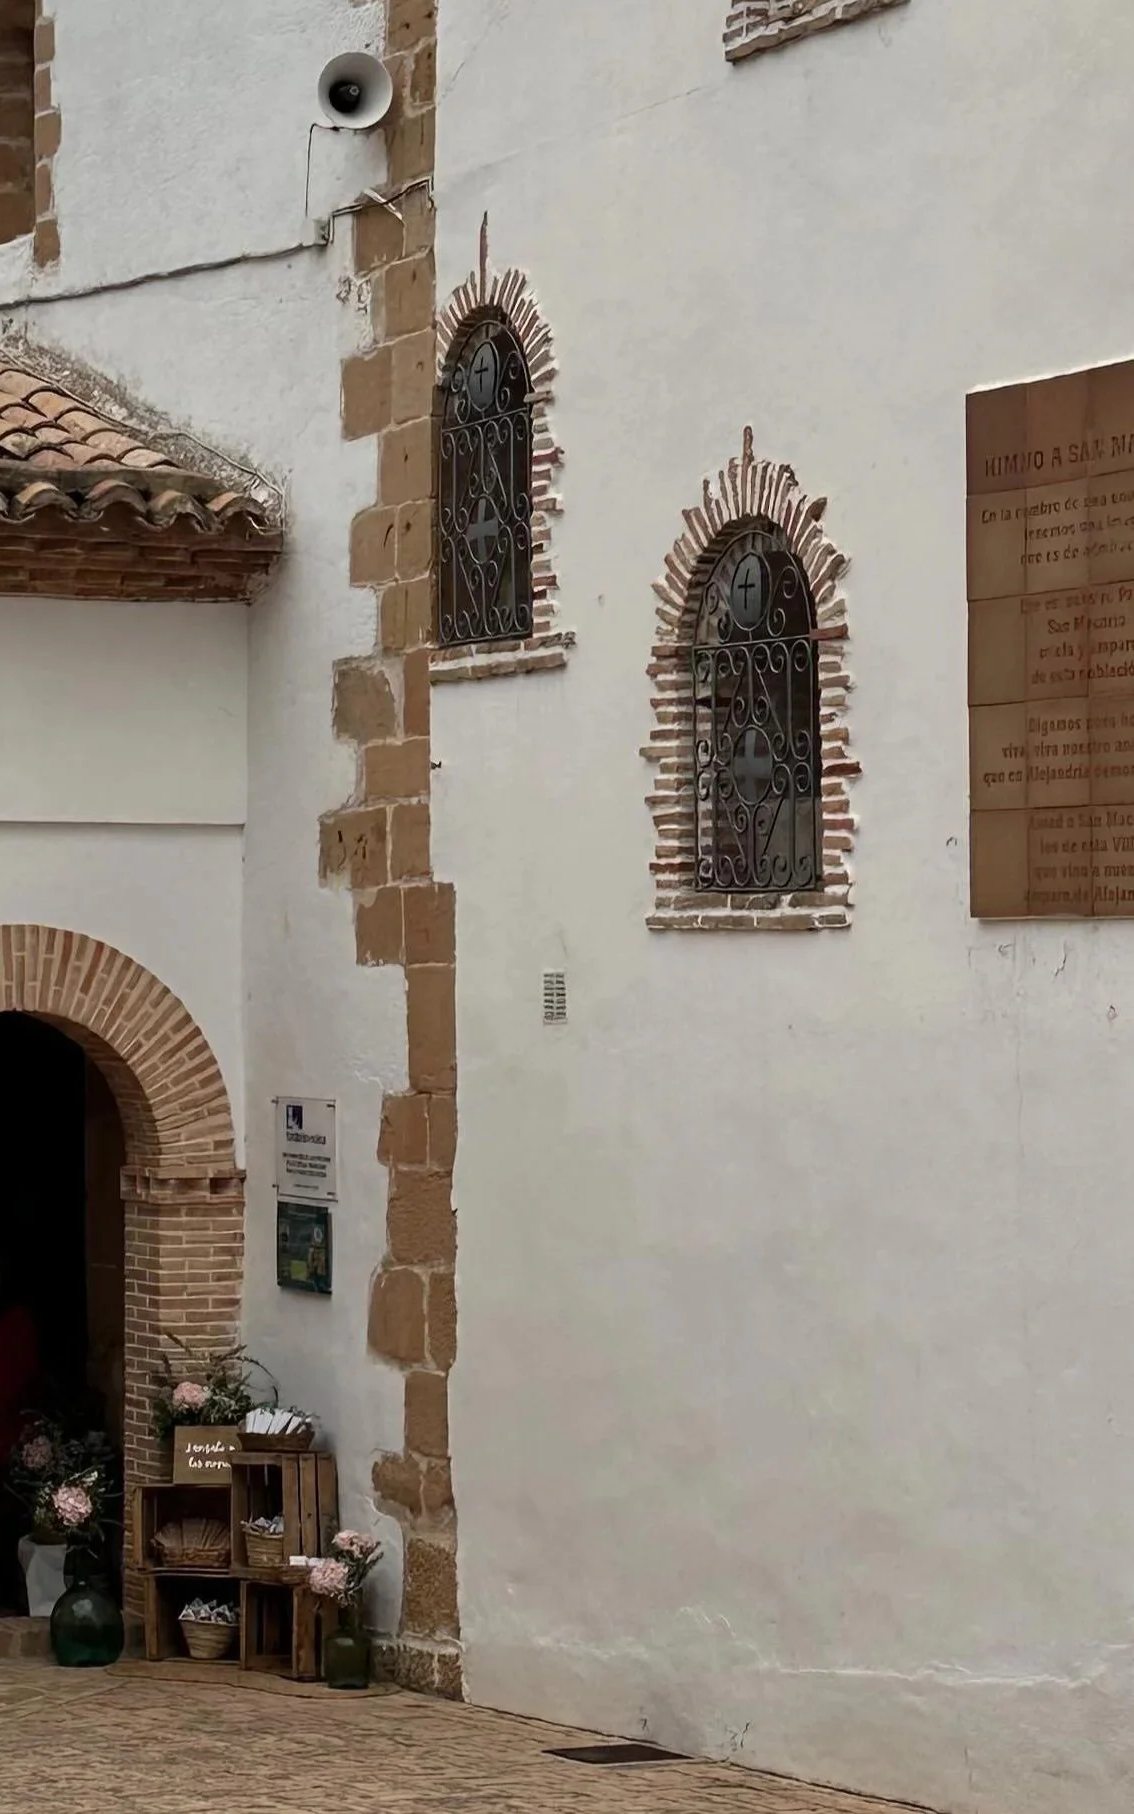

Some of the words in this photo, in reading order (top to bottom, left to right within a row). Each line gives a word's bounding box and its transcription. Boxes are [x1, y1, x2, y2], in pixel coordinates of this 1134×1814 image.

[985, 450, 1044, 477] HIMNO
[1051, 446, 1062, 468] A
[1068, 439, 1104, 463] SAN
[1063, 544, 1078, 560] de
[1008, 770, 1023, 783] en
